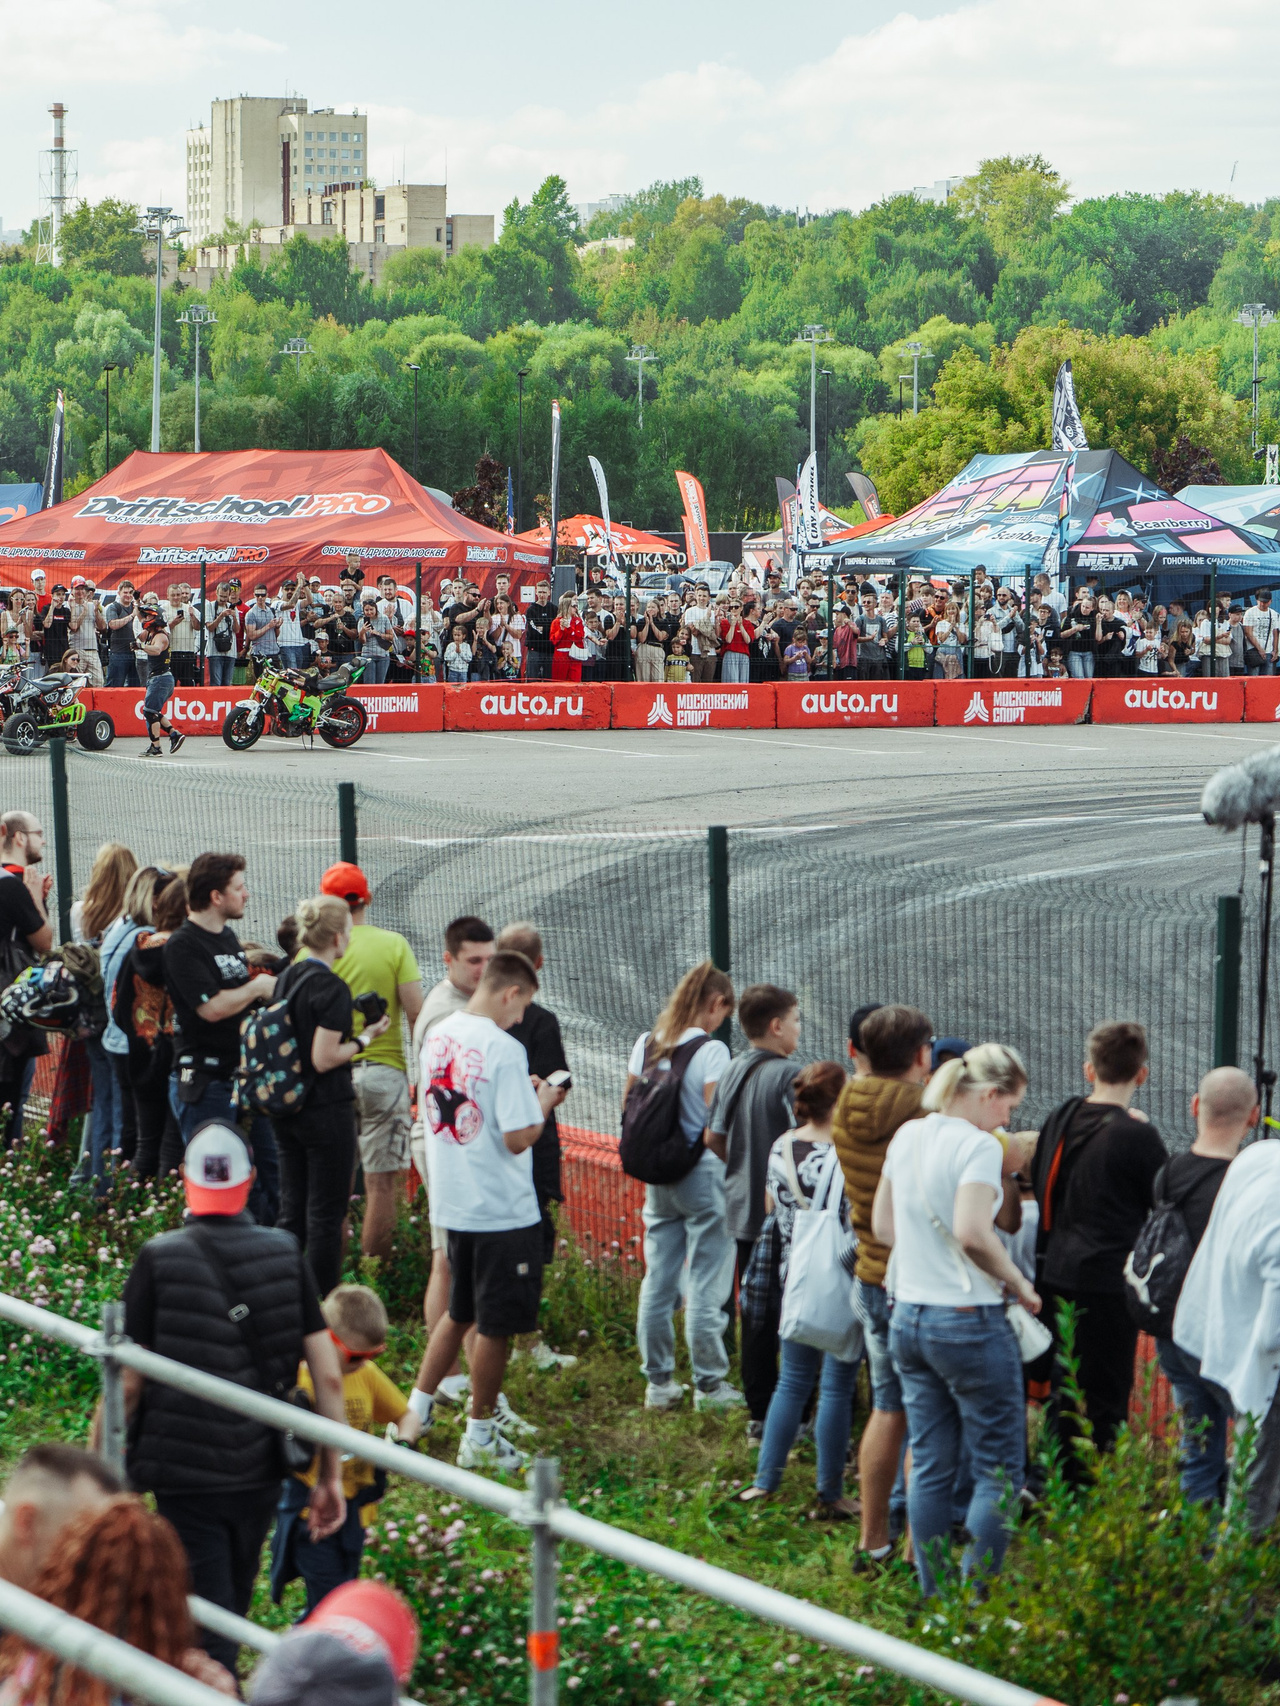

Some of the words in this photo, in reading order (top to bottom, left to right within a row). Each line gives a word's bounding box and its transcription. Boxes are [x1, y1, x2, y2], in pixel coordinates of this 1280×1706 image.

[1132, 518, 1212, 529] Scanberry
[991, 529, 1050, 545] Scanber
[9, 547, 44, 558] ДРИФТУ
[50, 550, 86, 559] МОСКВЕ
[321, 545, 367, 556] ОБУЧЕНИЕ
[367, 547, 403, 558] ДРИФТУ
[410, 548, 448, 558] МОСКВЕ
[622, 552, 663, 566] YUKA
[666, 552, 687, 566] AD
[1077, 553, 1138, 566] META
[1162, 556, 1204, 565] ГОНОЧНЫЕ
[353, 692, 418, 713] СКОВСКИЙ
[480, 692, 583, 715] auto.ru
[677, 690, 749, 710] МОСКОВСКИЙ
[801, 690, 898, 713] auto.ru
[993, 687, 1062, 707] МОСКОВСКИЙ
[1124, 687, 1217, 710] auto.ru
[677, 710, 711, 726] СПОРТ
[993, 707, 1026, 723] СПОРТ
